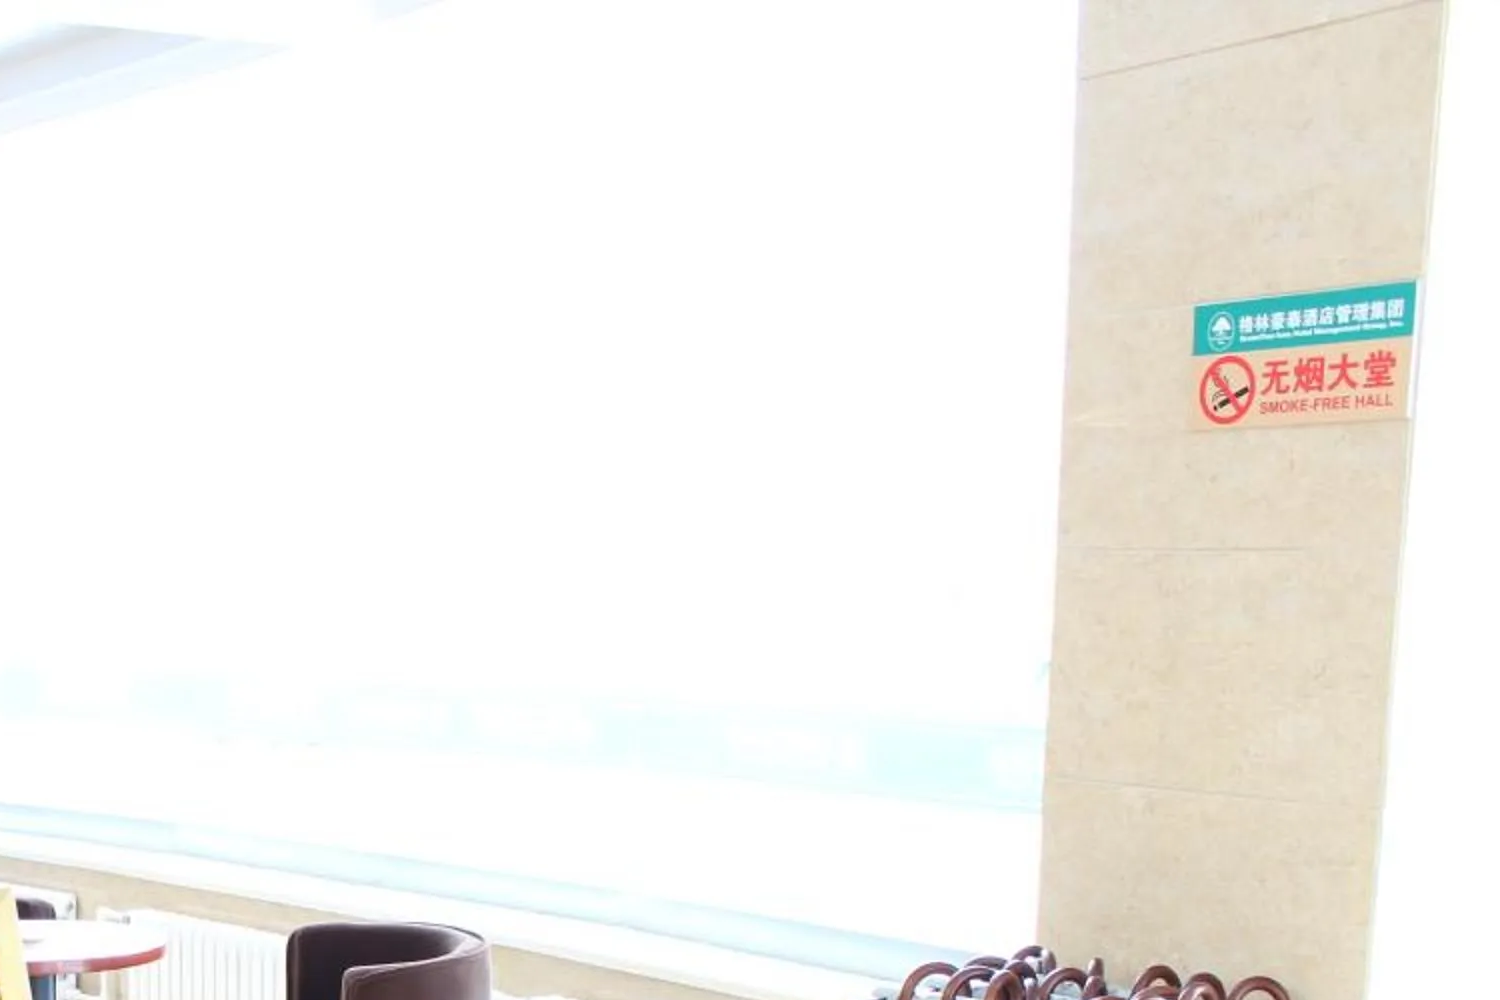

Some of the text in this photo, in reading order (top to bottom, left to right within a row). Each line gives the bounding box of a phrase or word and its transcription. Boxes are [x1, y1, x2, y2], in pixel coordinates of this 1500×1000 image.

[1238, 298, 1405, 334] 格林豪泰酒店管理集团
[1260, 350, 1397, 395] 无烟大堂
[1259, 393, 1394, 414] SMOKE-FREE HALL
